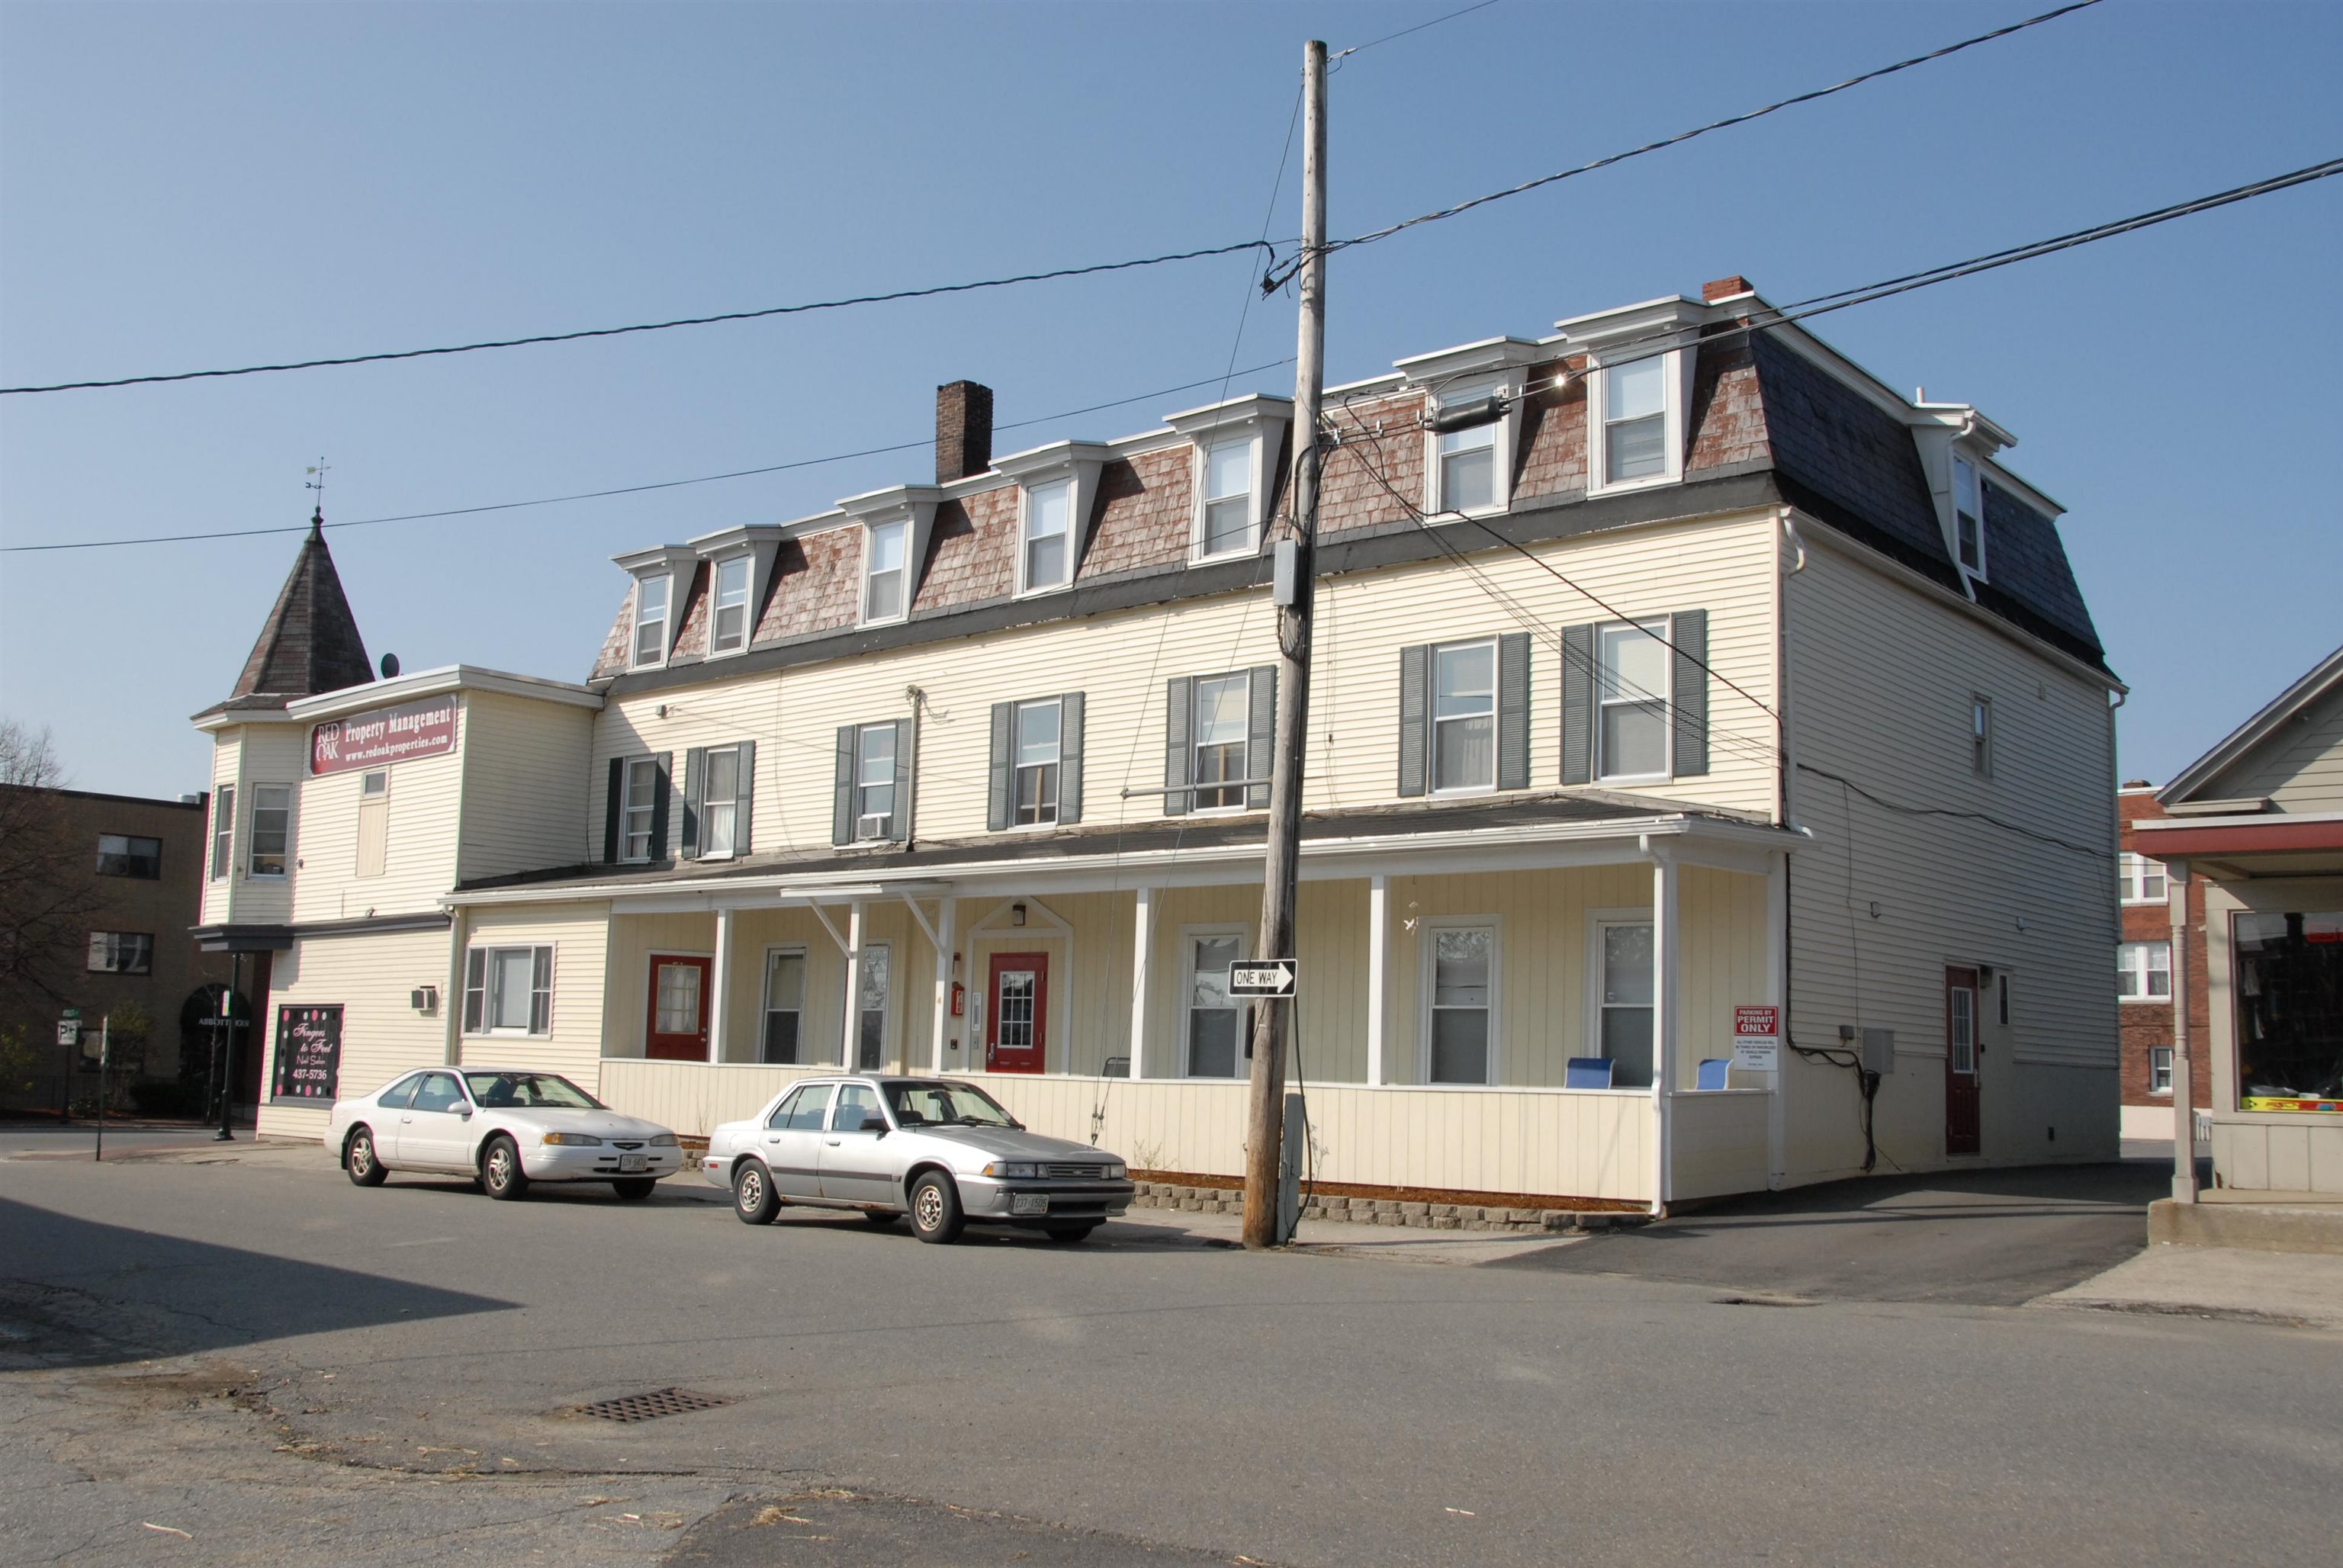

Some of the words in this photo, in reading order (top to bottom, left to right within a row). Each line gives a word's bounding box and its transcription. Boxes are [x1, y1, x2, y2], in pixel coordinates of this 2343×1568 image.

[318, 722, 339, 744] RED
[346, 721, 385, 744] Property
[388, 706, 451, 733] Management
[316, 741, 339, 761] OAK
[346, 734, 448, 762] www.redoakproperties.com
[1236, 972, 1255, 985] ONE
[1258, 972, 1278, 985] WAY
[293, 1023, 326, 1042] Fingers
[1740, 1023, 1771, 1033] ONLY
[301, 1043, 308, 1052] to
[297, 1055, 309, 1065] Nail
[310, 1055, 326, 1065] Salon
[293, 1068, 327, 1080] 437-5736
